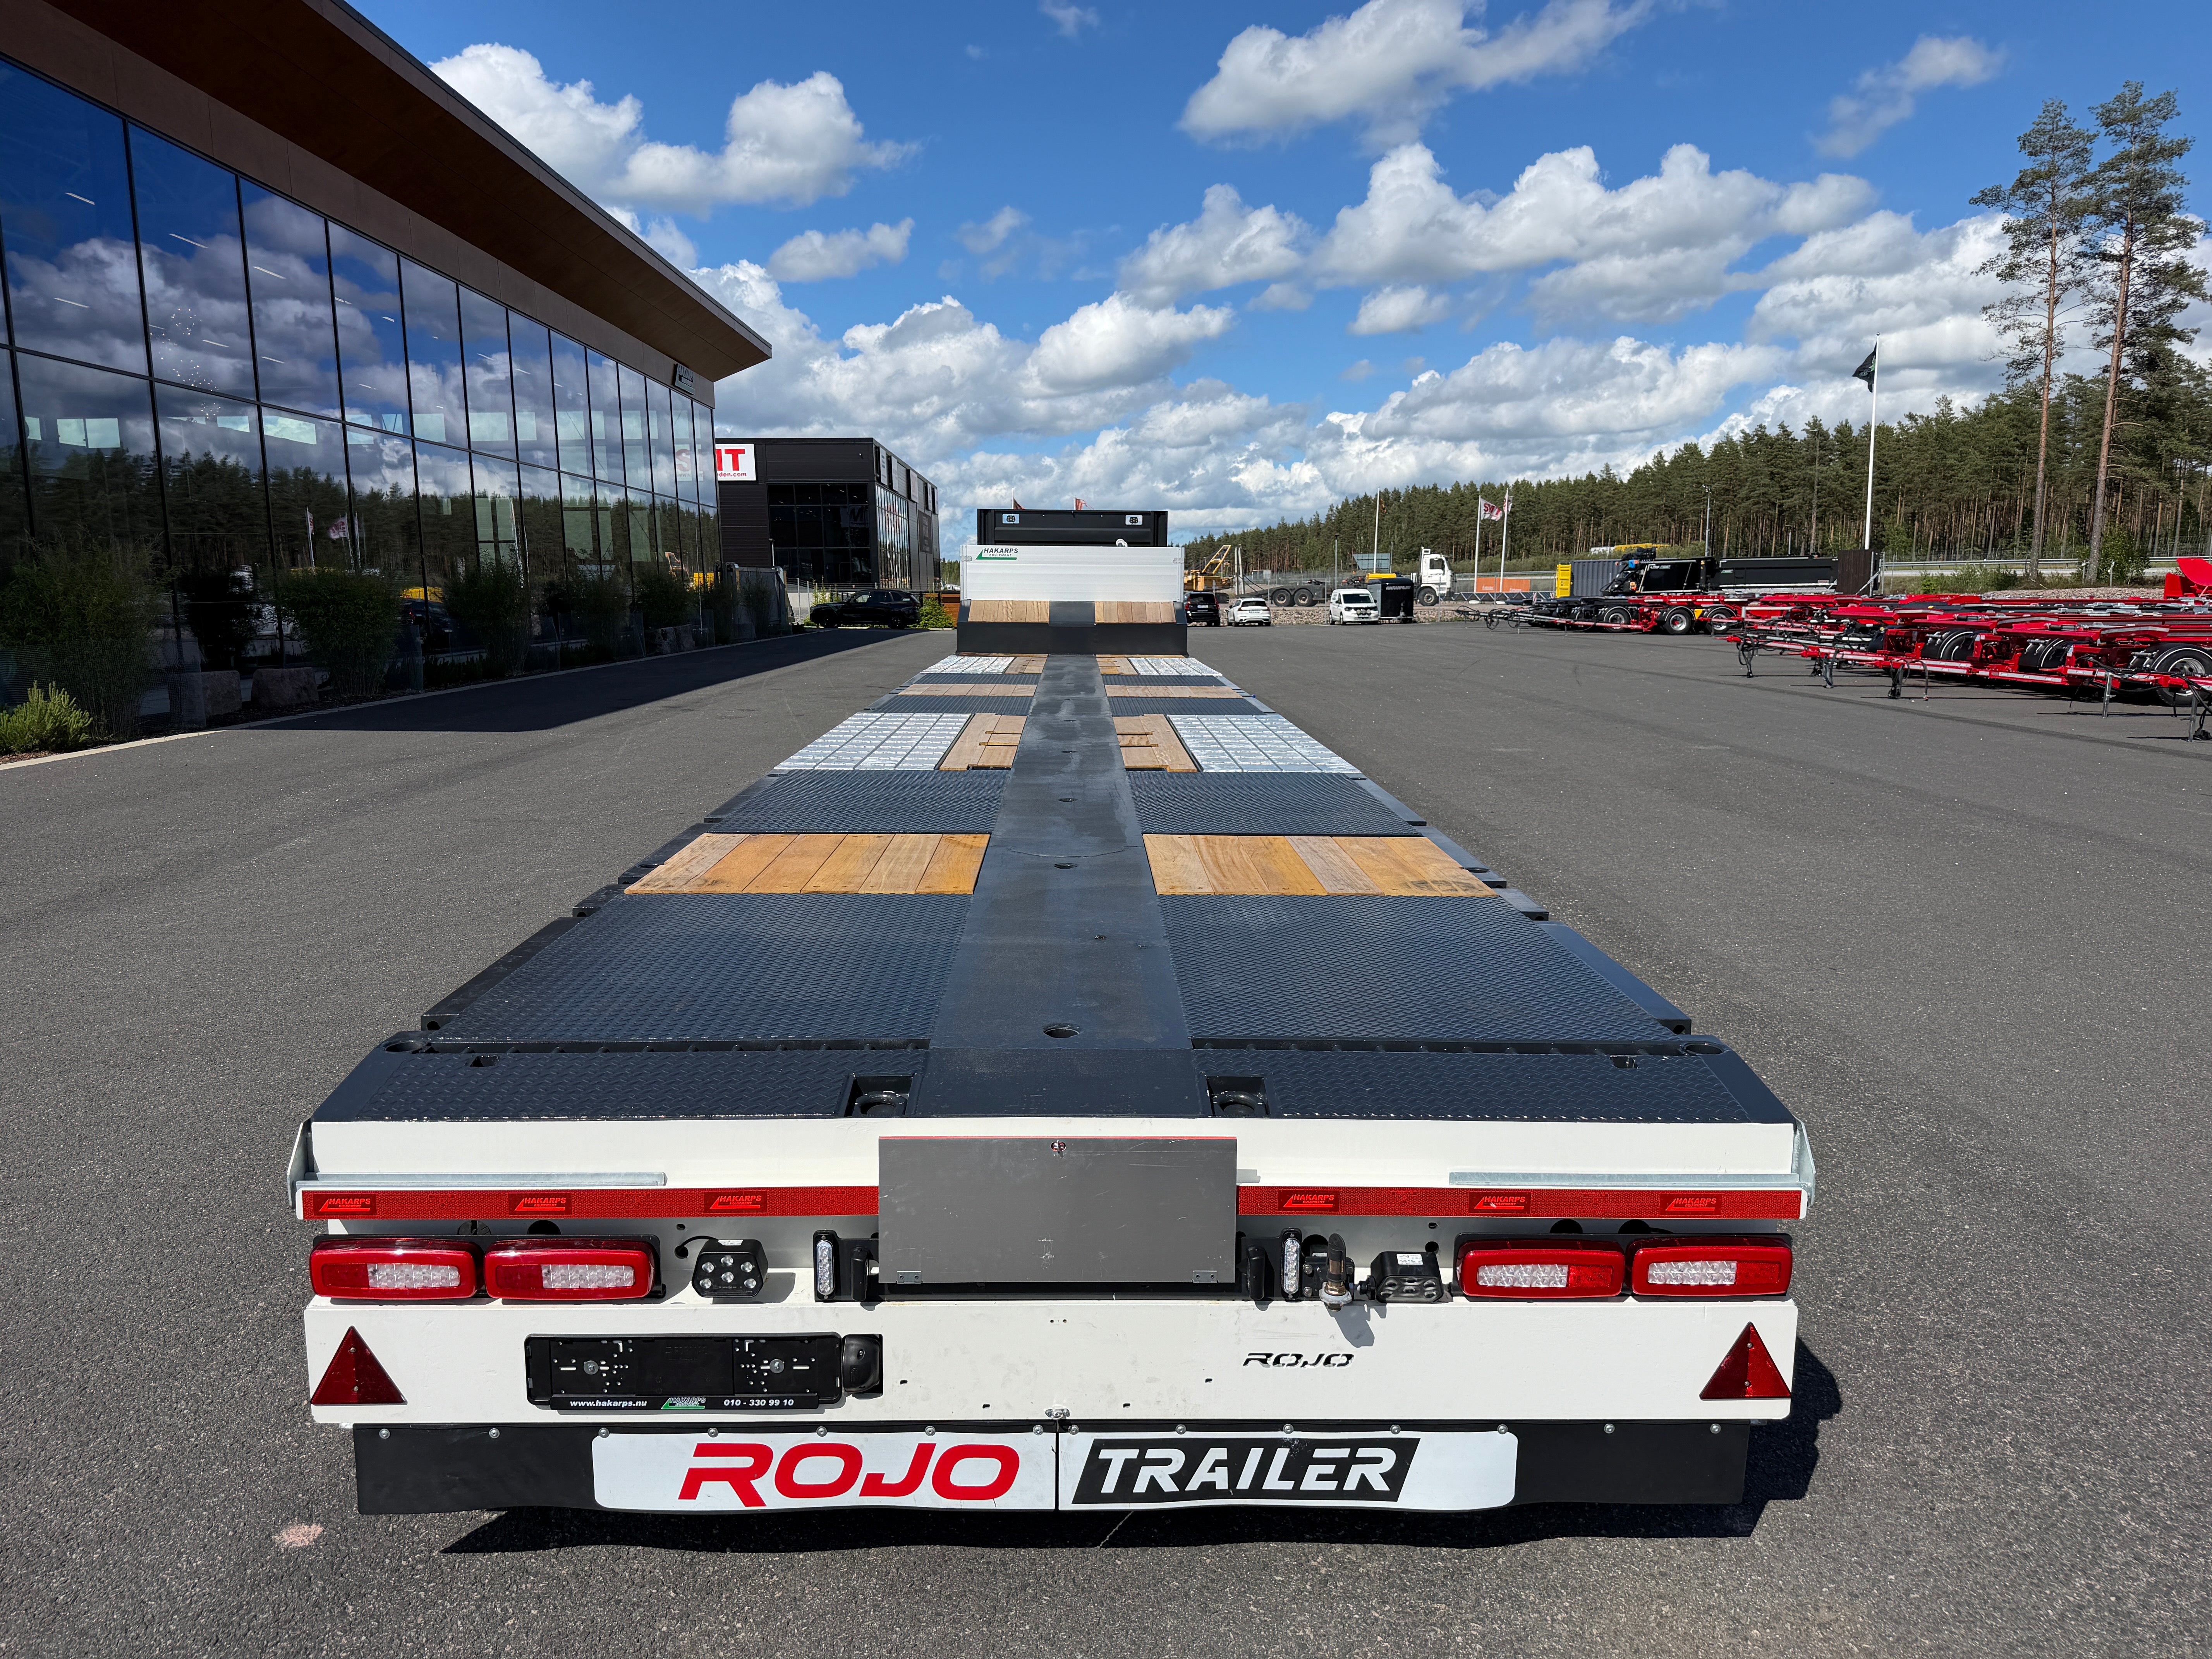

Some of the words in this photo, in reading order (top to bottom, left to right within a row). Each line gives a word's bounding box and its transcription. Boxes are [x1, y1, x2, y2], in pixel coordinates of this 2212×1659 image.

[1243, 1353, 1354, 1368] ROJO
[570, 1400, 647, 1408] www.hakarps.nu
[678, 1443, 1020, 1507] ROJO
[1098, 1448, 1397, 1494] TRAILER
